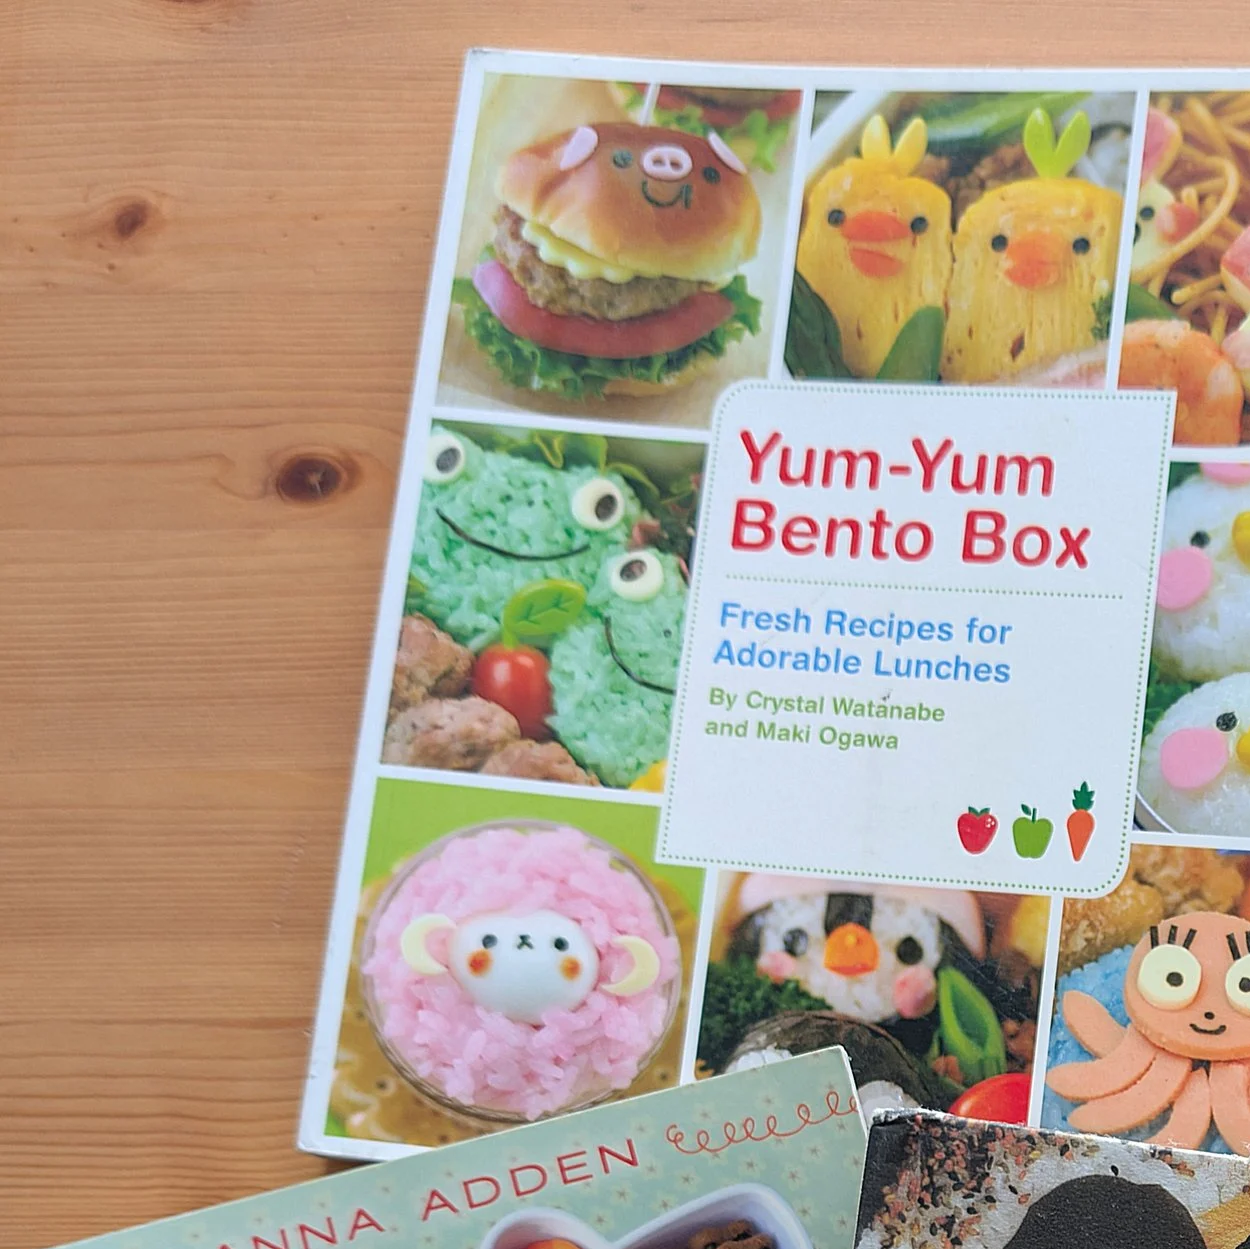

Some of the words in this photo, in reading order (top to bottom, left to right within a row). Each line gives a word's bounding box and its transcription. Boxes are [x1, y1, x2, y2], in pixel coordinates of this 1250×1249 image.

[739, 429, 1054, 497] Yum-Yum
[731, 499, 933, 562] Bento
[962, 509, 1092, 569] Box
[719, 602, 812, 635] Fresh
[824, 610, 954, 645] Recipes
[966, 616, 1013, 644] for
[713, 640, 862, 674] Adorable
[874, 656, 1011, 683] Lunches
[709, 688, 737, 711] By
[746, 690, 825, 717] Crystal
[832, 697, 946, 722] Watanabe
[705, 718, 748, 740] and
[756, 722, 811, 744] Maki
[819, 726, 899, 750] Ogawa
[420, 1136, 639, 1223] ADDEN
